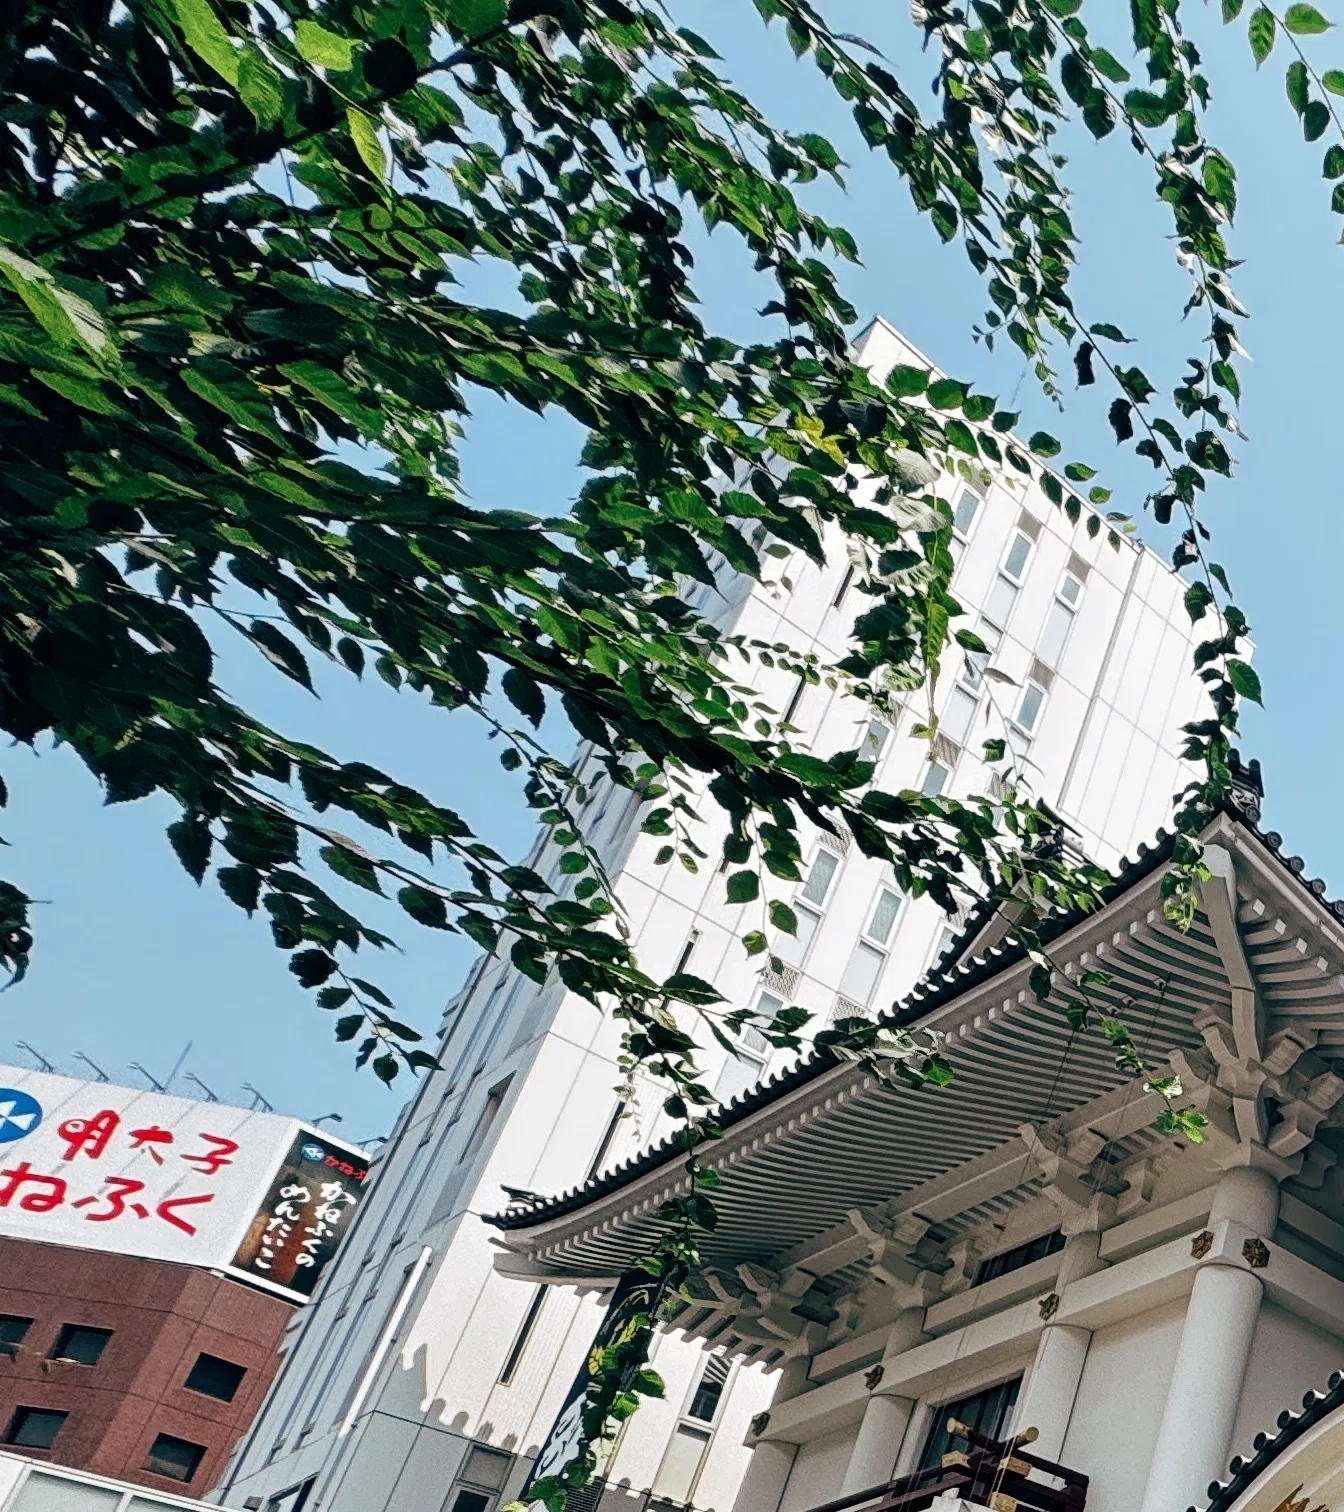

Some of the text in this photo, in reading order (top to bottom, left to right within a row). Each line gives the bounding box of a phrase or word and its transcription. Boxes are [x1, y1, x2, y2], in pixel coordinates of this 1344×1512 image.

[57, 1109, 240, 1175] 明太子
[295, 1180, 358, 1268] かねふくの
